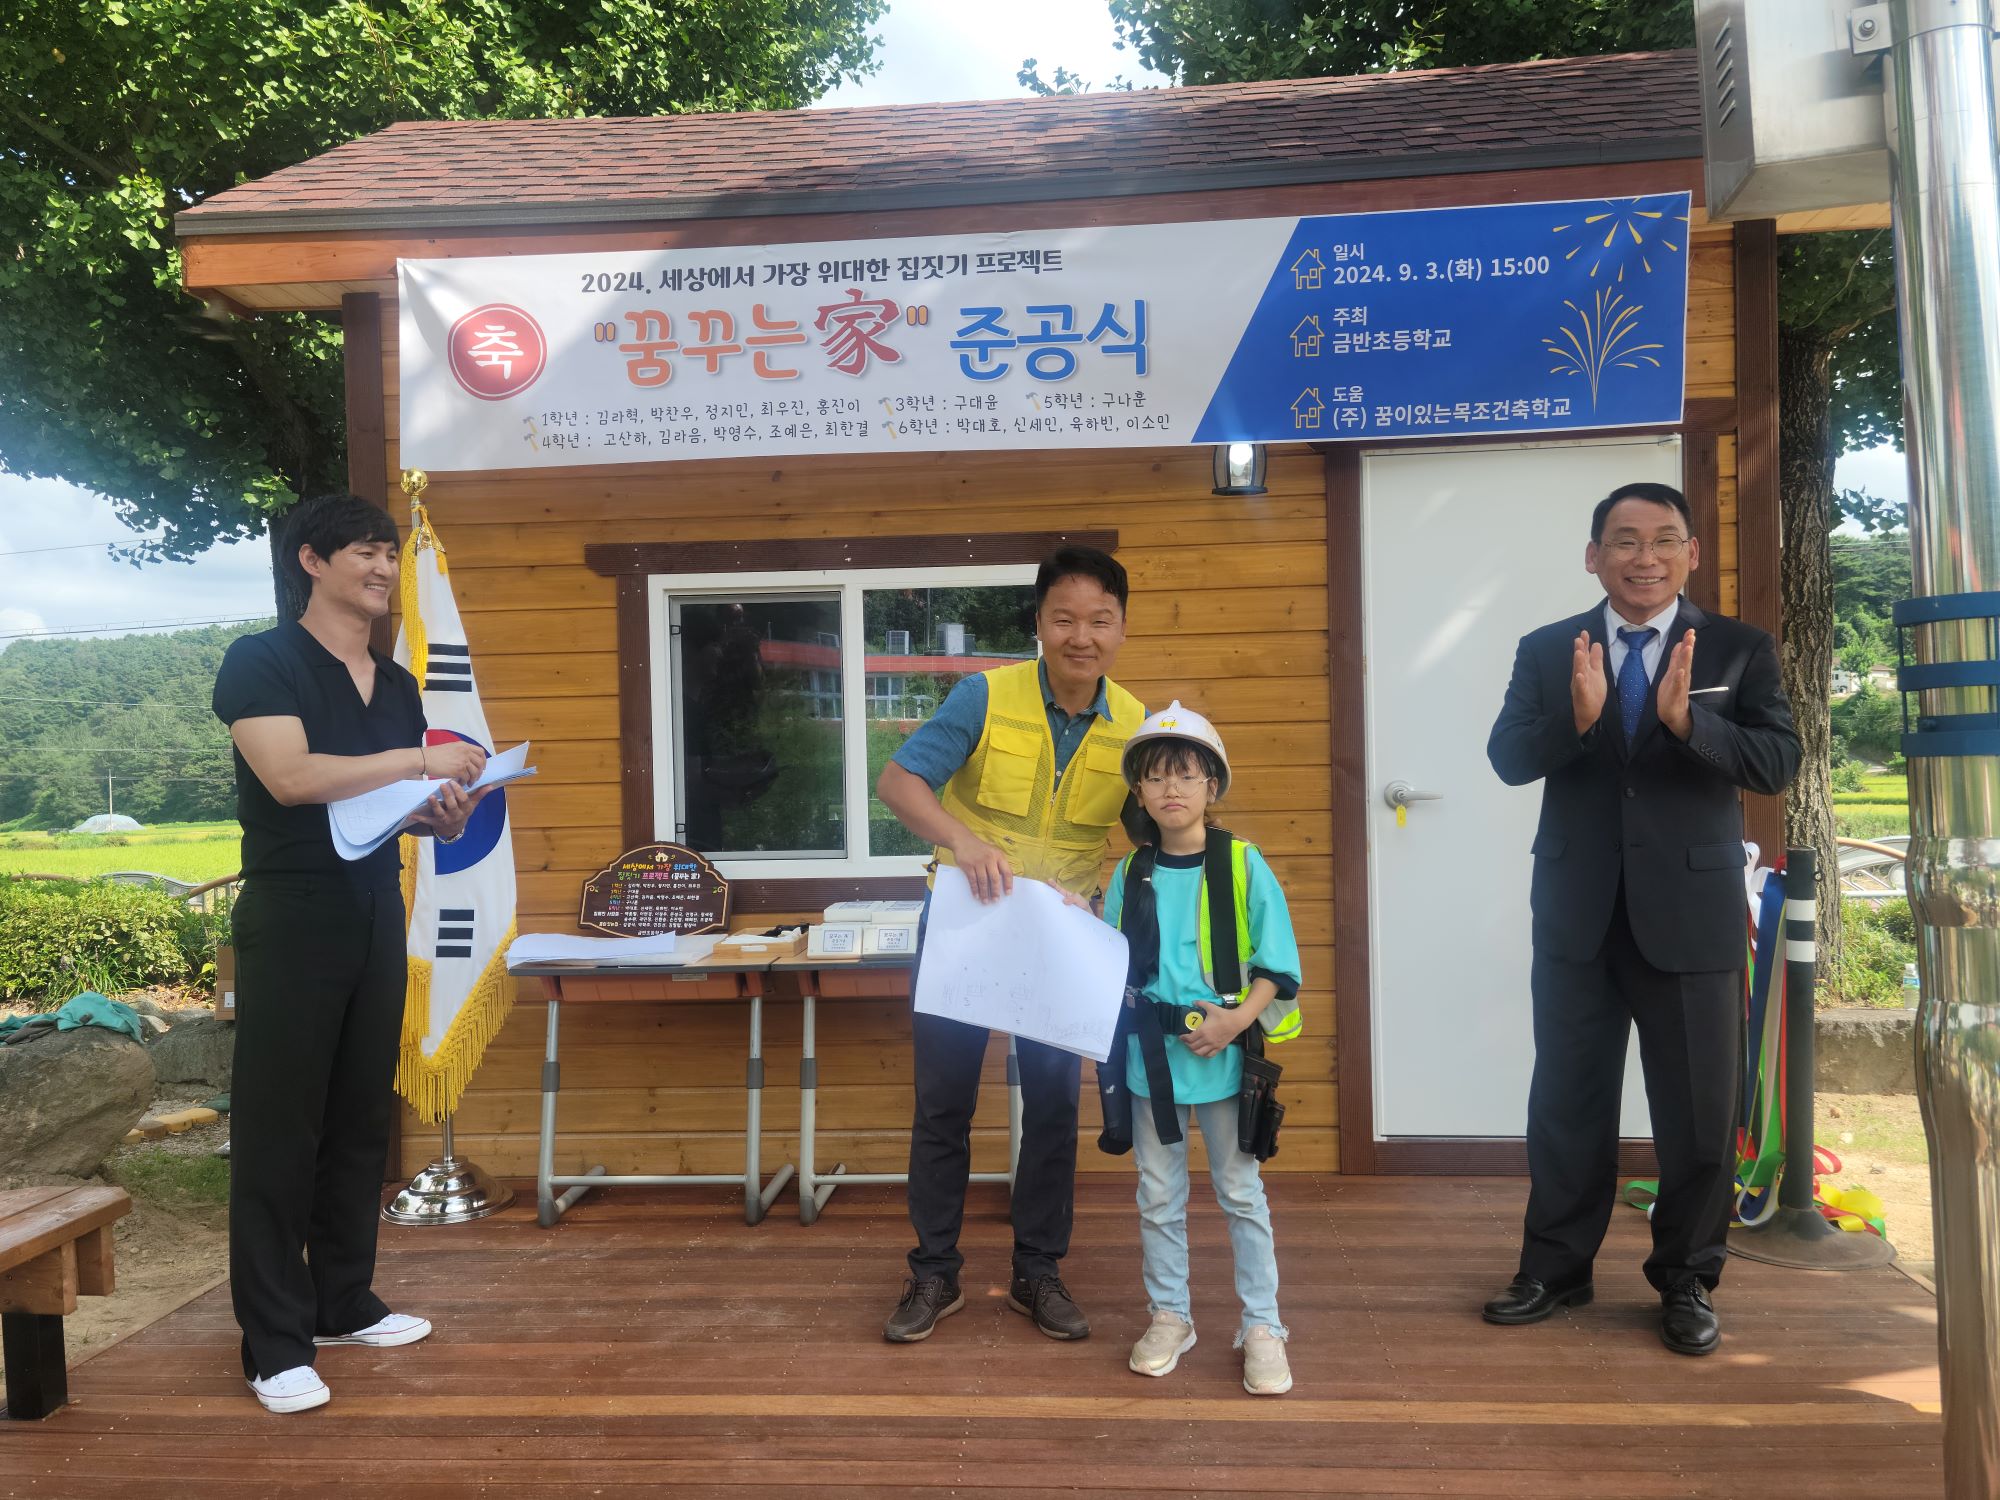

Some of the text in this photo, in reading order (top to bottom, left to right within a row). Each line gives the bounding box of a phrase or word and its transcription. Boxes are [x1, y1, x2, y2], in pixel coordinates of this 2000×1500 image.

[1333, 243, 1365, 261] 일시
[581, 249, 1063, 295] 2024. 세상에서 가장 위대한 집짓기 프로젝트
[1333, 264, 1392, 285] 2024.
[1398, 262, 1418, 281] 9.
[1490, 255, 1550, 277] 15:00
[1333, 306, 1368, 327] 주최
[467, 324, 524, 379] 축
[949, 298, 1150, 383] 준공식
[1332, 328, 1452, 354] 금반초등학교
[895, 395, 934, 412] 3학년
[954, 394, 998, 411] 구대윤
[1044, 392, 1083, 409] 5학년
[1102, 390, 1146, 408] 구나훈
[1332, 385, 1364, 403] 도움
[542, 411, 577, 427] 1학년
[597, 408, 644, 426] 김라혁,
[651, 406, 699, 422] 박찬우,
[705, 402, 754, 421] 정지민,
[761, 400, 810, 417] 최우진,
[817, 398, 860, 416] 홍진이
[898, 418, 938, 435] 6학년
[957, 417, 1007, 434] 박대호,
[1014, 415, 1063, 433] 신세민,
[1070, 415, 1119, 432] 육하빈,
[1126, 413, 1170, 430] 이소민
[1332, 397, 1572, 430] (주) 꿈이있는목조건축학교
[542, 433, 579, 449] 4학년
[604, 431, 652, 446] 고산하,
[659, 427, 706, 445] 김라음,
[713, 425, 762, 442] 박영수,
[769, 422, 818, 439] 조예은,
[825, 420, 869, 438] 최한결
[622, 863, 697, 872] 세상에서 가장 위대한
[642, 872, 669, 880] 프로젝트
